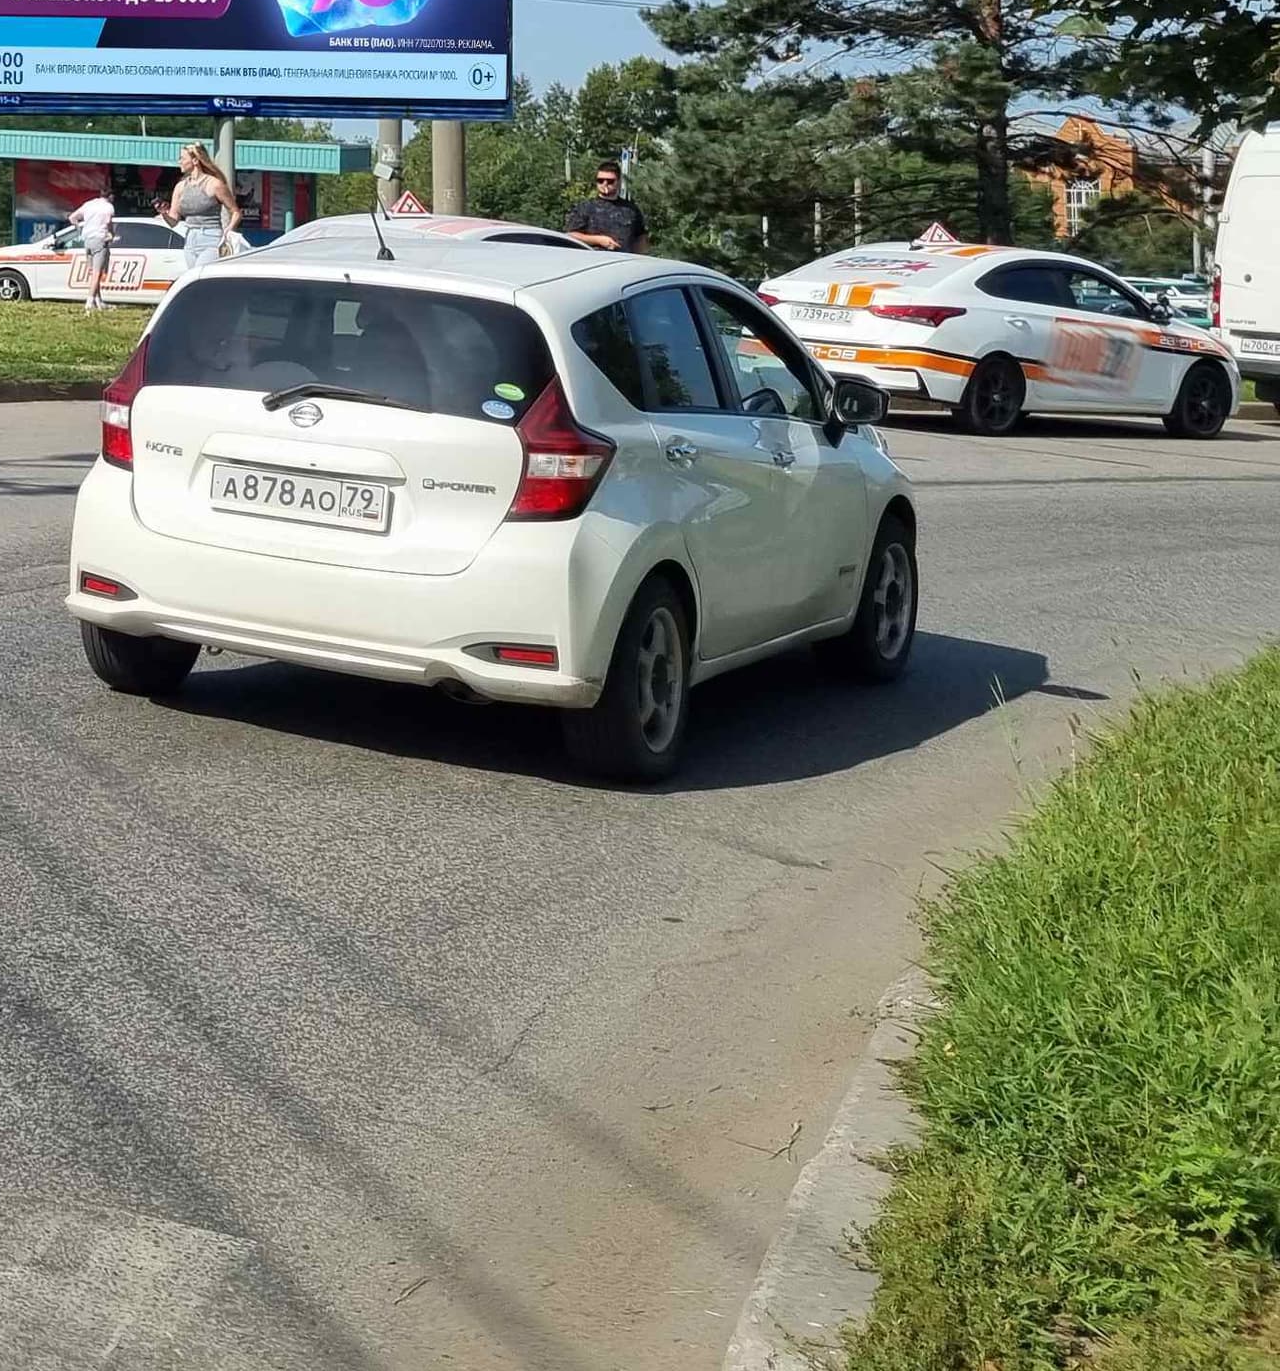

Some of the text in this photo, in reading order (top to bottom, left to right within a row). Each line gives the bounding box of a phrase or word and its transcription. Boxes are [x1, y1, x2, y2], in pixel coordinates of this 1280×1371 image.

[329, 37, 352, 47] БАНК
[353, 37, 370, 48] ВТБ
[35, 63, 56, 74] БАНК
[57, 64, 87, 75] ВПРАВЕ
[87, 64, 124, 75] ОТКАЗАТЬ
[125, 65, 138, 75] БЕЗ
[139, 65, 186, 76] ОБЪЯСНЕНИЯ
[220, 67, 241, 77] БАНК
[242, 67, 258, 77] ВТБ
[283, 67, 333, 79] ГЕНЕРАЛЬНАЯ
[334, 68, 372, 80] ЛИЦЕНЗИЯ
[372, 69, 398, 80] БАНКА
[398, 69, 429, 80] РОССИИ
[472, 68, 494, 85] 0+
[145, 440, 184, 457] NOTE
[223, 473, 374, 513] А878АО 79
[341, 506, 363, 518] RUS
